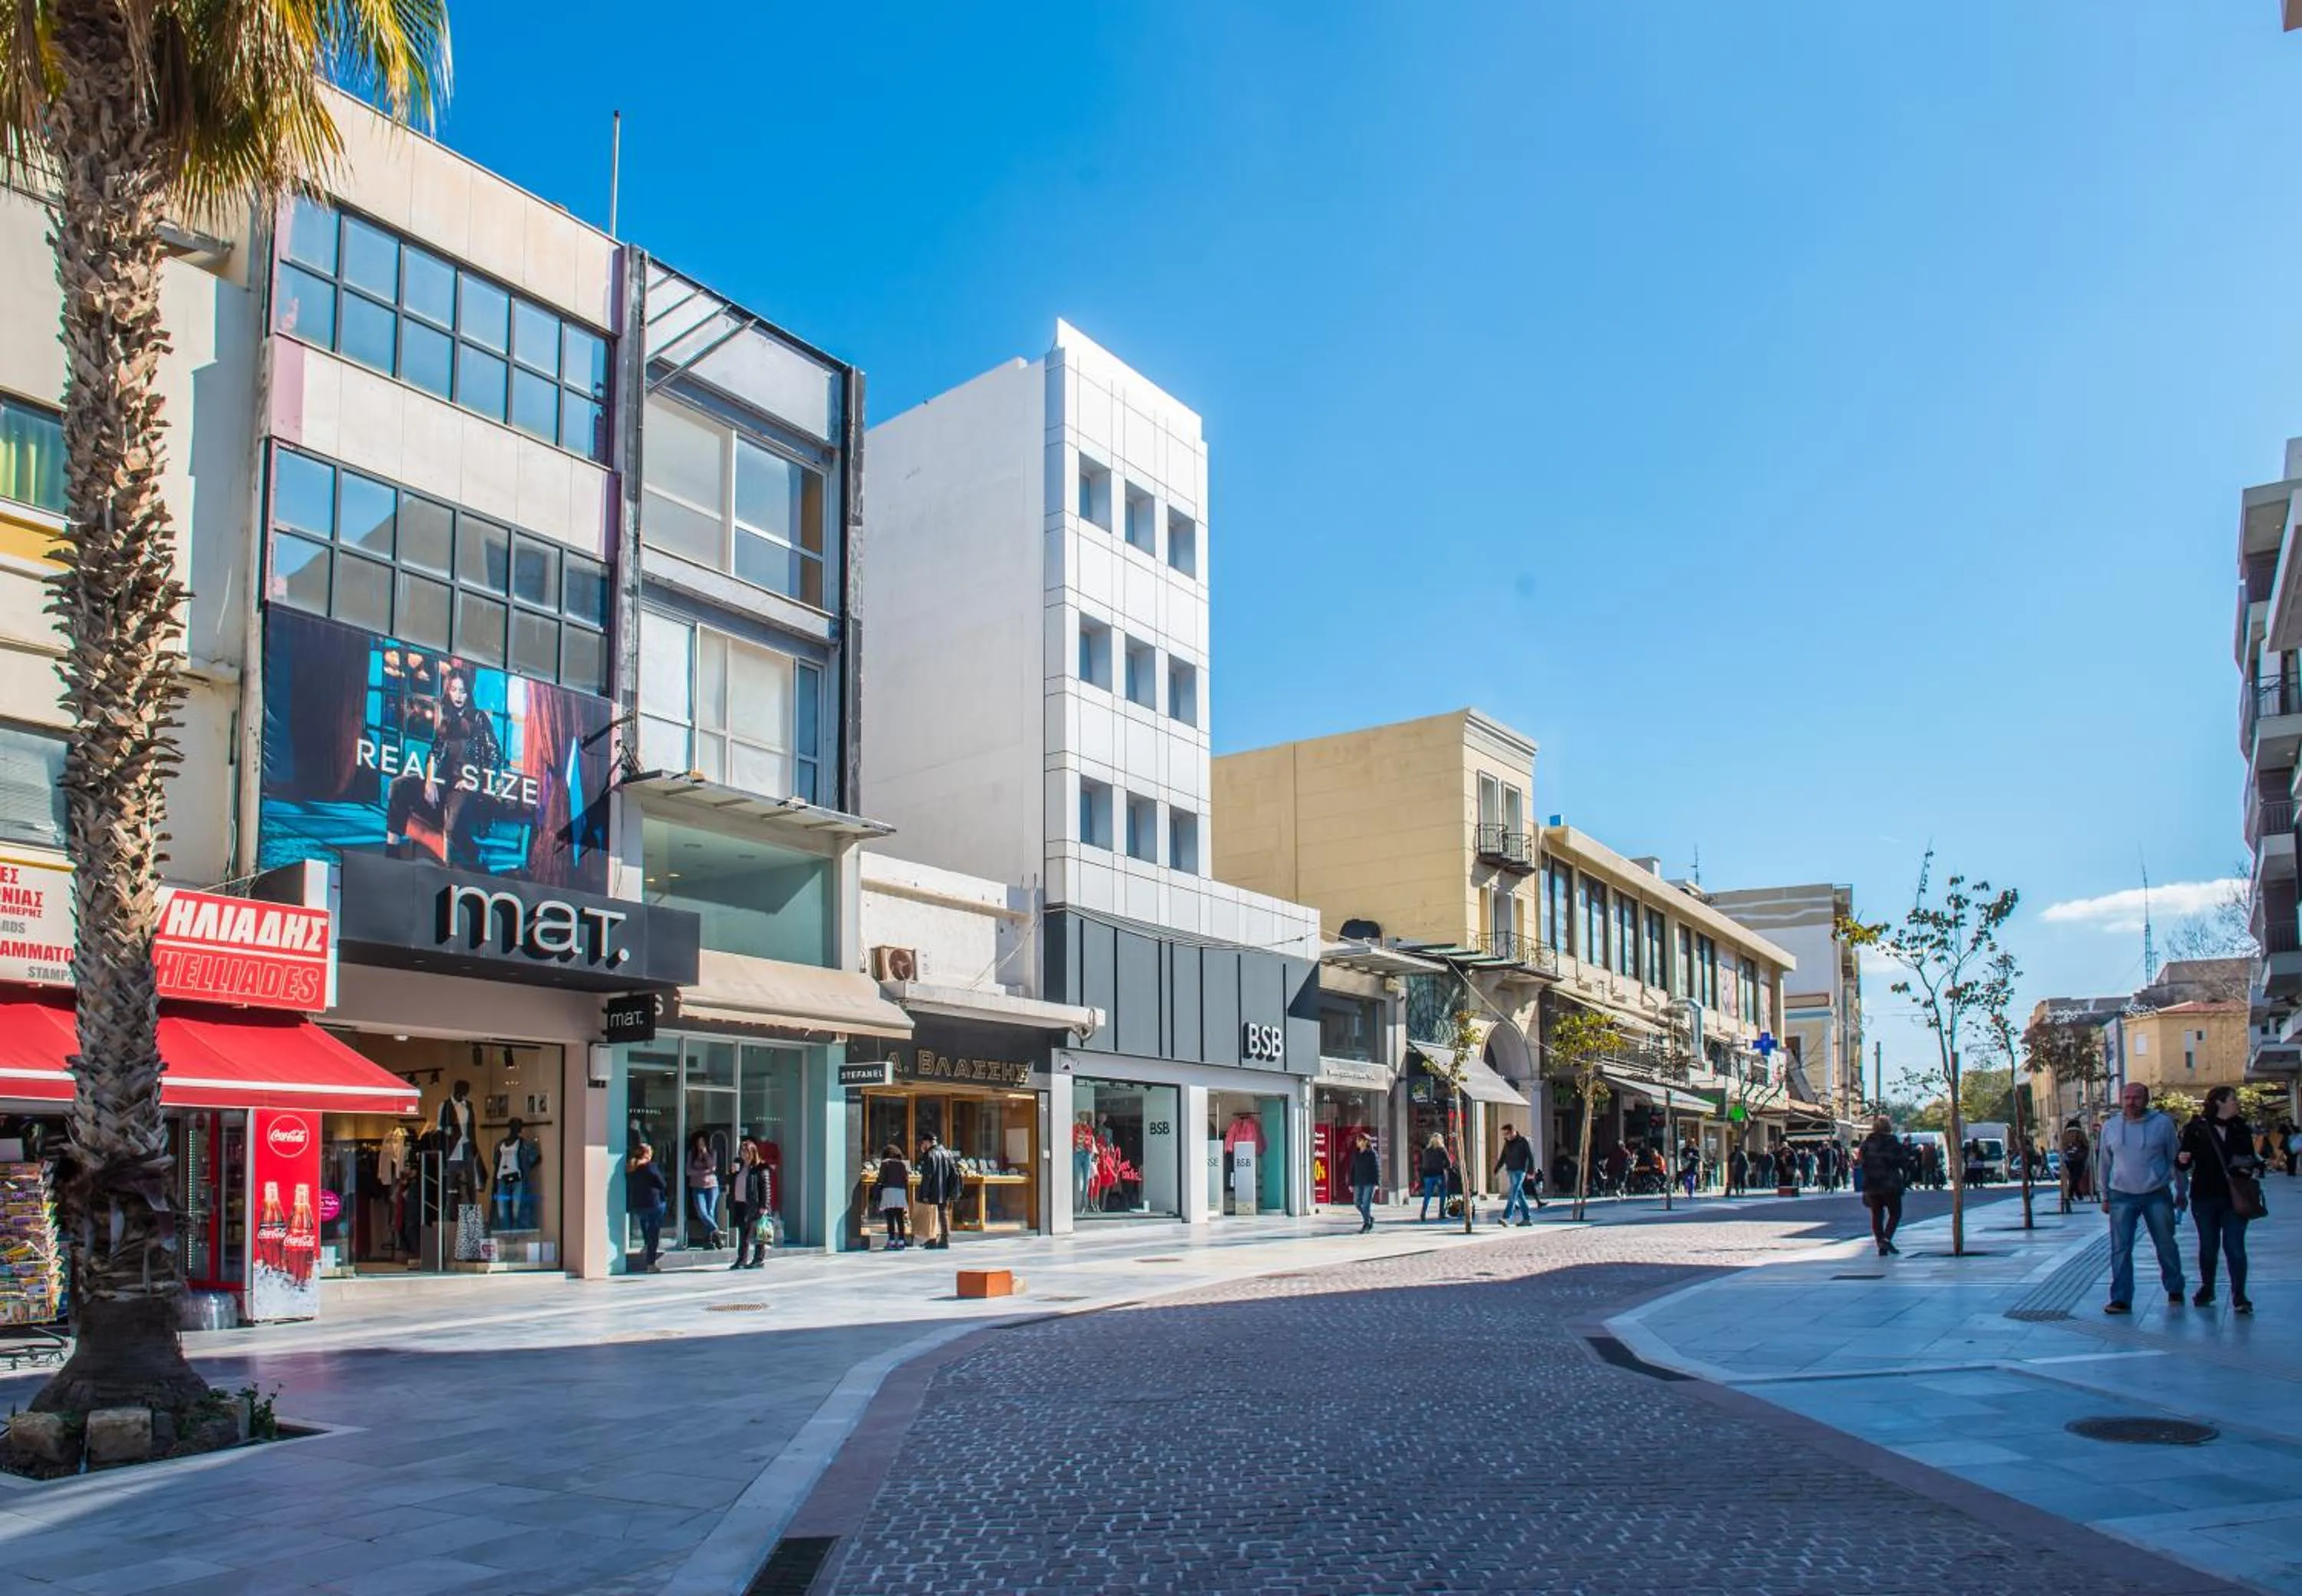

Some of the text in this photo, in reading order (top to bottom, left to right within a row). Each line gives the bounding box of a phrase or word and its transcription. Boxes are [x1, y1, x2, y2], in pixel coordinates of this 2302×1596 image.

[356, 738, 538, 805] REAL SIZE
[0, 887, 43, 908] ΝΙΑΣ
[164, 899, 328, 952] ΗΛΙΑΔΗΣ
[157, 950, 319, 1004] HELLIADES
[1248, 1023, 1283, 1057] BSB
[841, 1069, 882, 1080] STEFANEL
[1149, 1122, 1170, 1134] BSB
